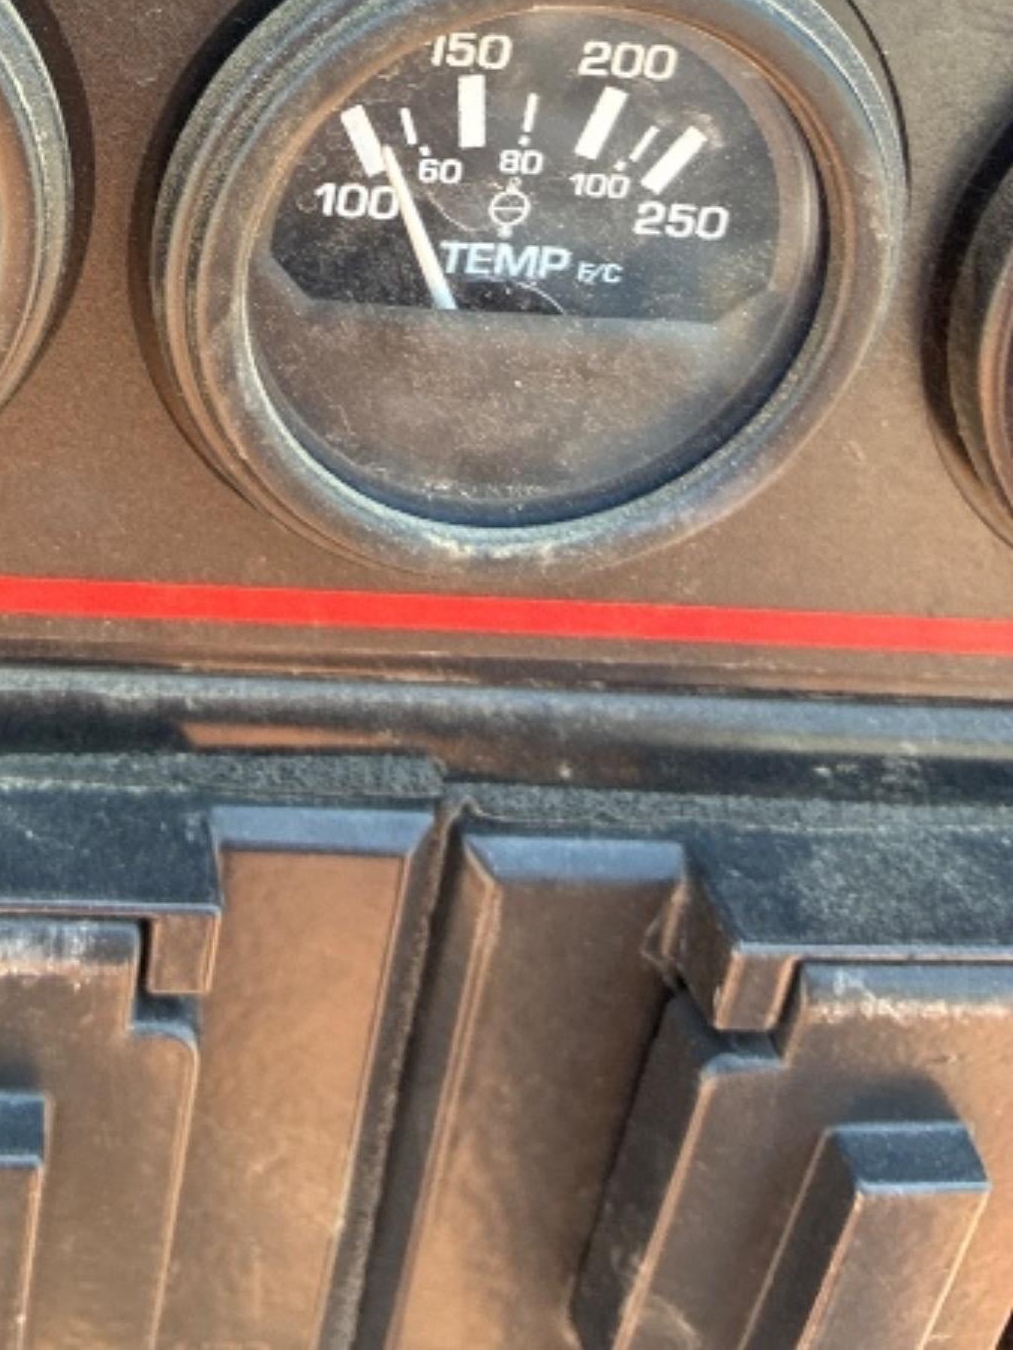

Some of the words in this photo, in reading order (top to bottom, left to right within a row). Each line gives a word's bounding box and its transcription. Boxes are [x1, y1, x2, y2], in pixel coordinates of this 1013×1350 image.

[430, 33, 513, 70] 150
[577, 41, 678, 82] 200
[417, 158, 462, 185] 60
[498, 150, 544, 175] 80
[313, 183, 400, 220] 100
[568, 173, 631, 200] 100
[633, 201, 730, 240] 250
[439, 240, 573, 283] TEMP
